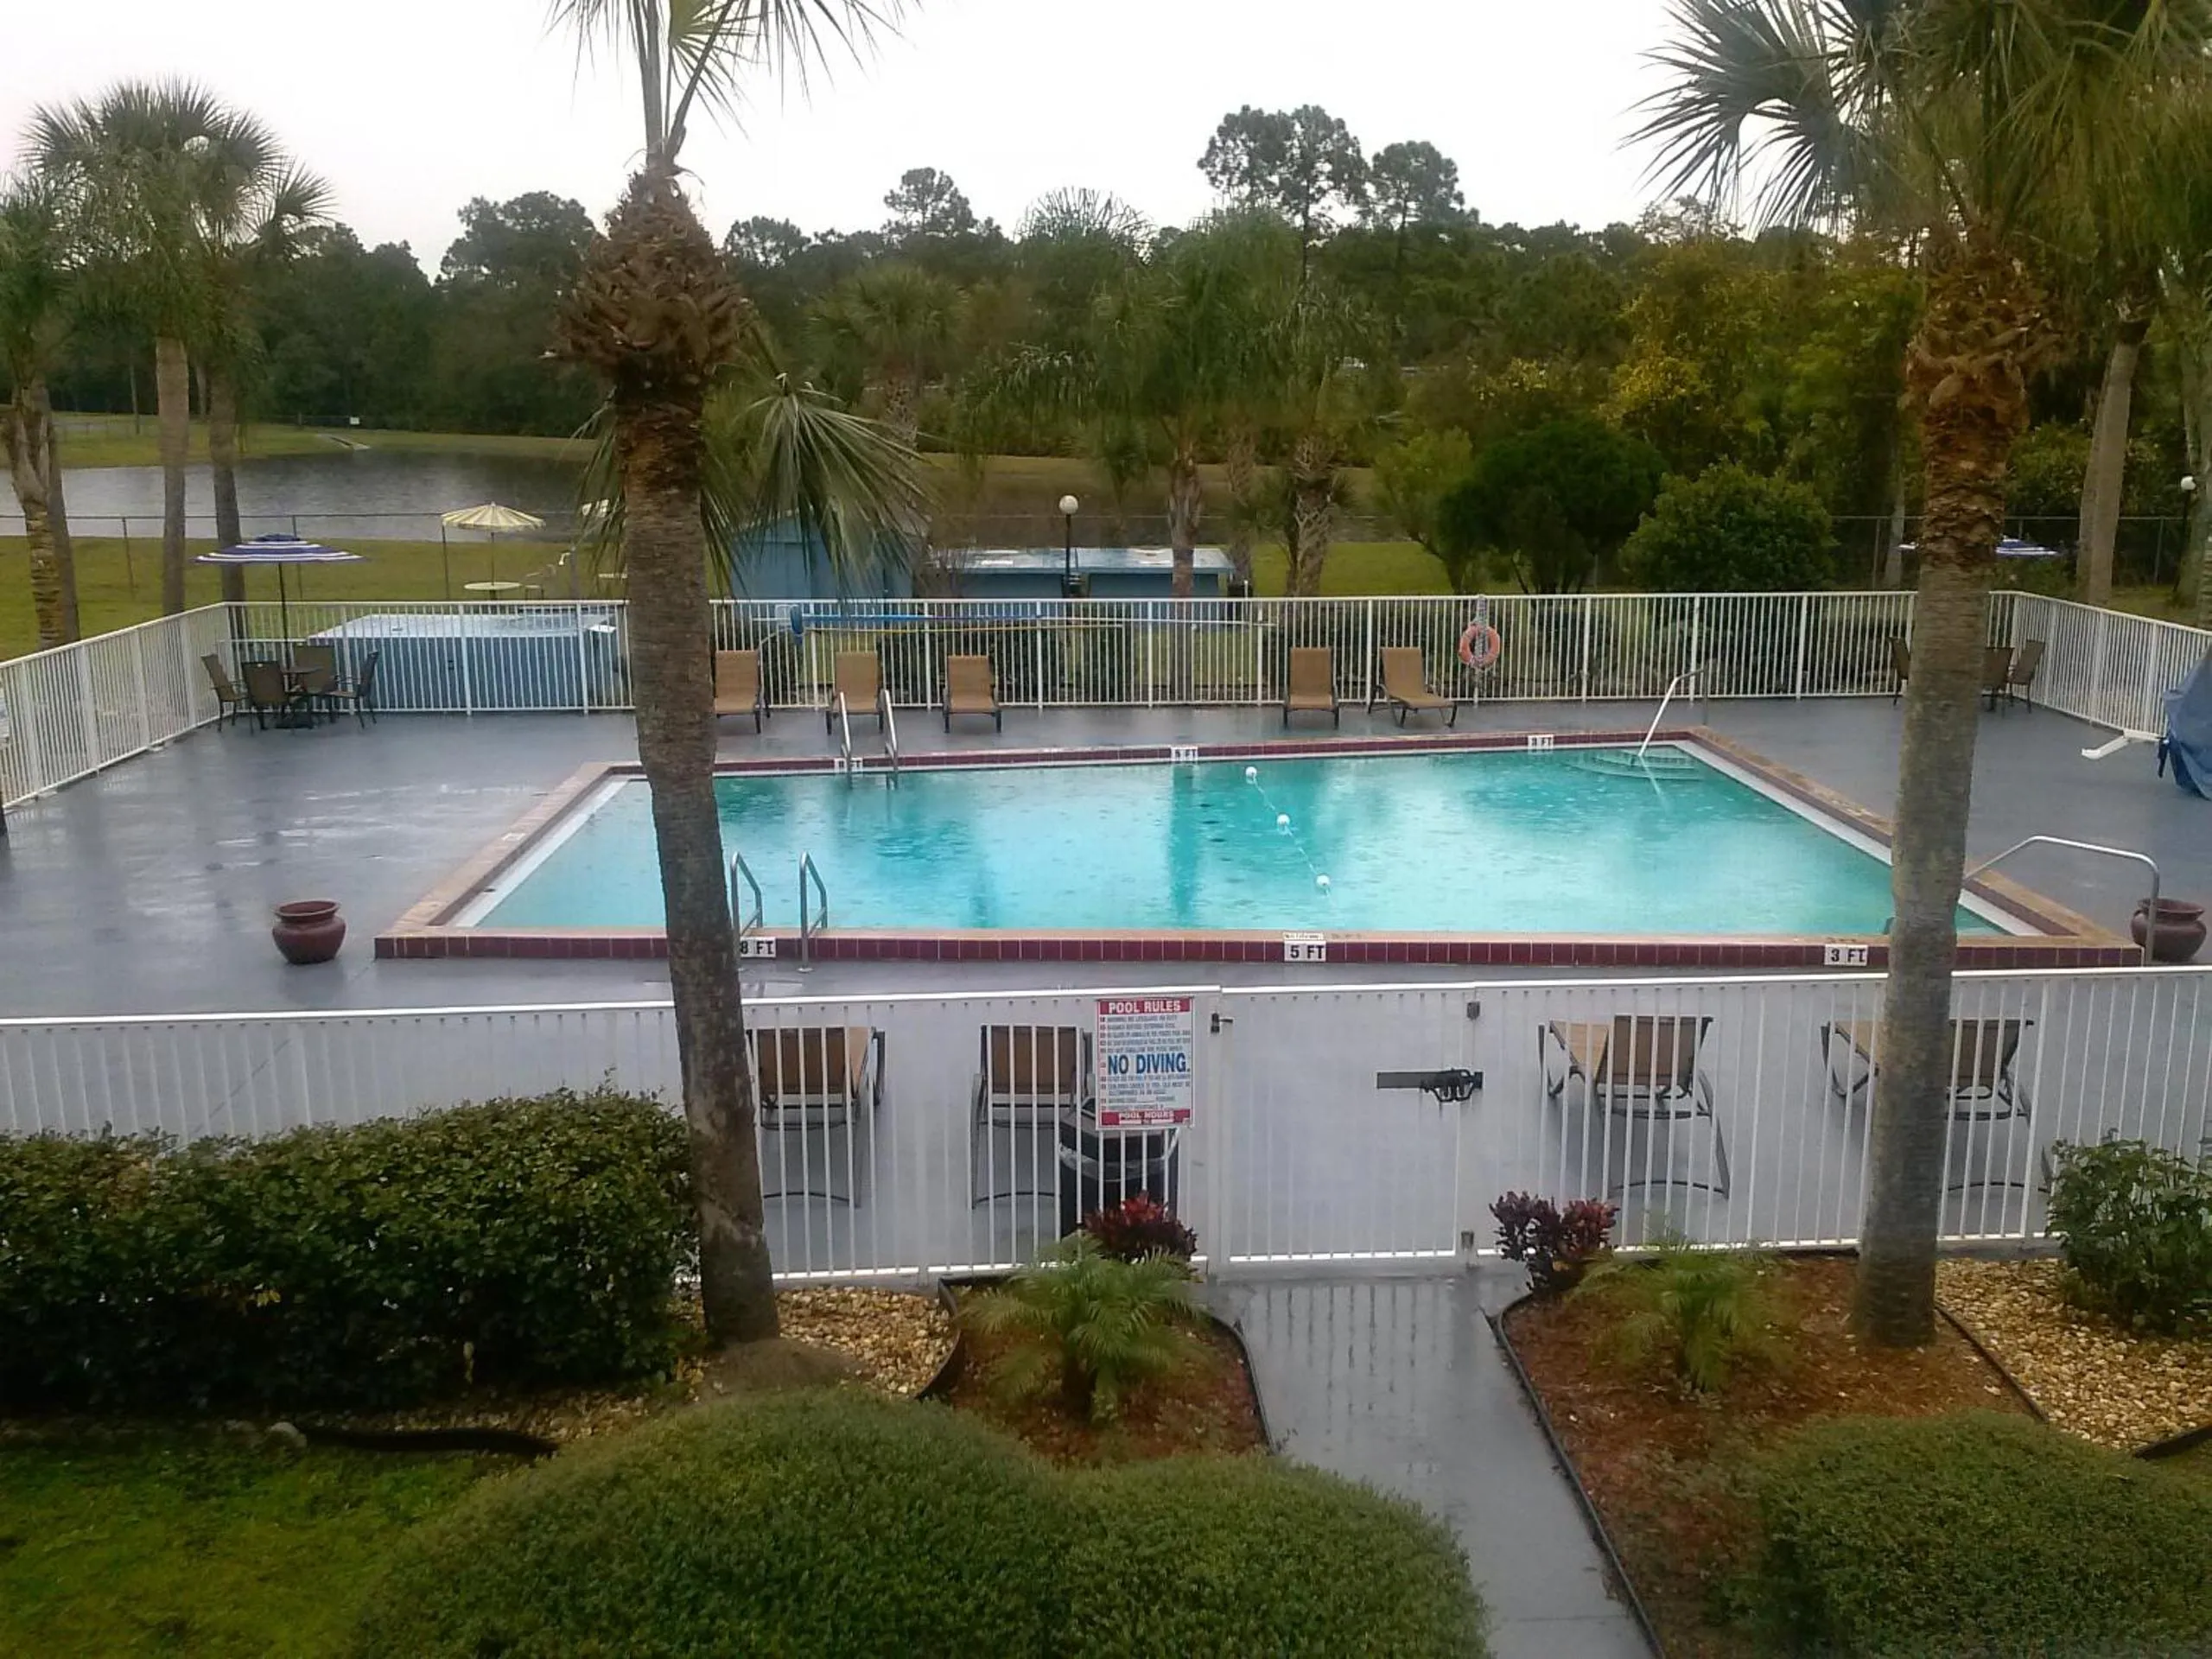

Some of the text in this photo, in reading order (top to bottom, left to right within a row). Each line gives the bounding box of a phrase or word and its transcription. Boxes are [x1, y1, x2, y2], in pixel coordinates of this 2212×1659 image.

[740, 940, 774, 955] 8 FT
[1290, 945, 1325, 959] 5 FT
[1831, 949, 1866, 962] 3 FT
[1109, 1001, 1181, 1014] POOL RULES
[1108, 1052, 1191, 1074] NO DIVING.
